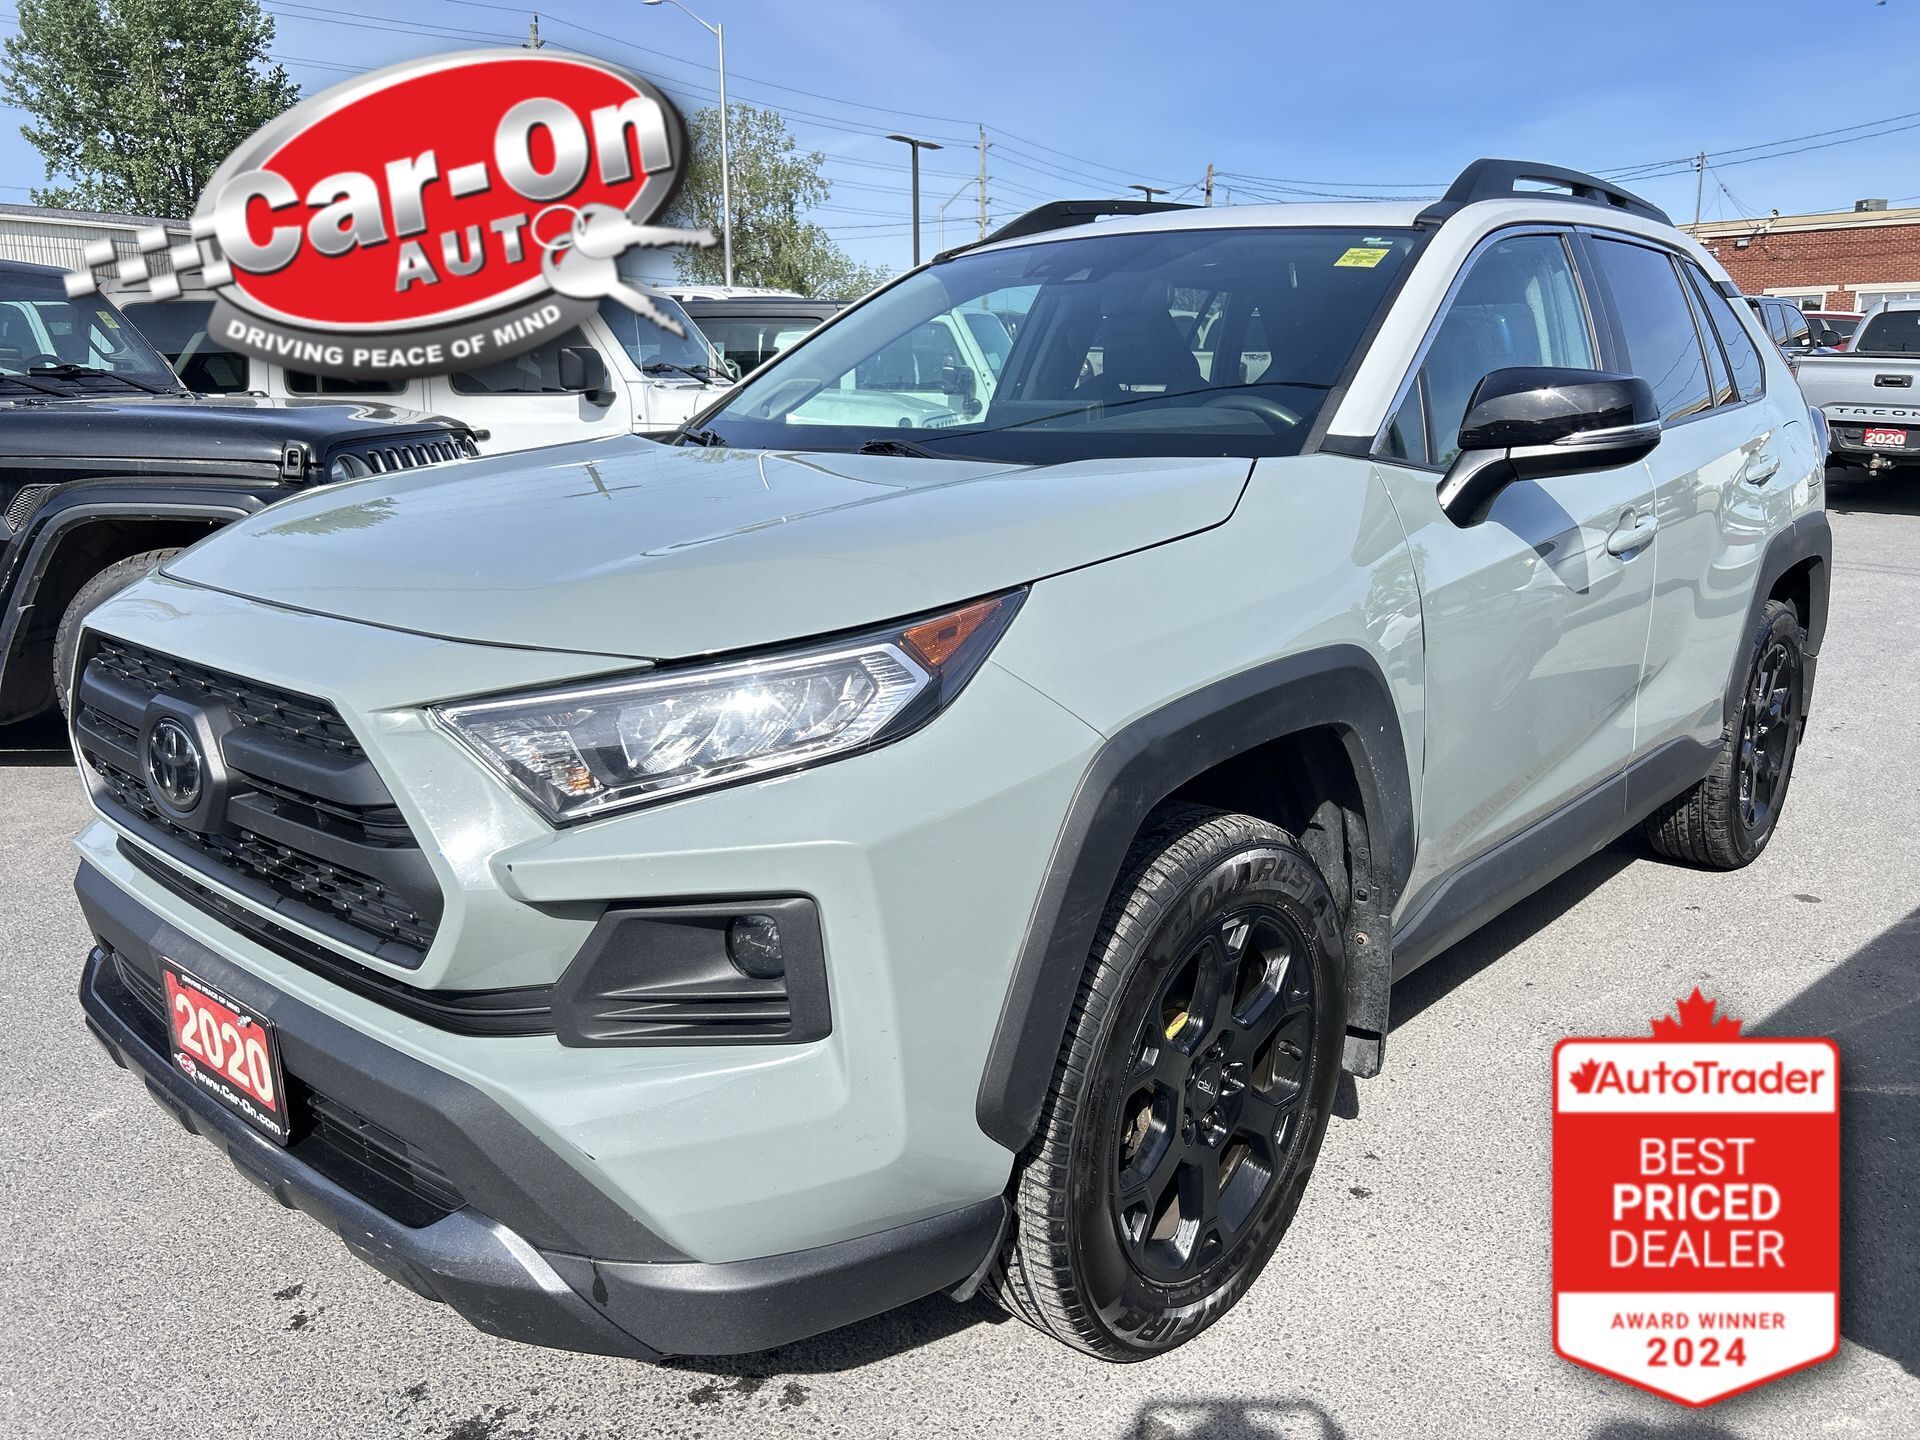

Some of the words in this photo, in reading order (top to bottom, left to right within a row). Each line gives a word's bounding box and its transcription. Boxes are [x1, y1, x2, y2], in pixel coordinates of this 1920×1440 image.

[1866, 432, 1905, 444] 2020
[175, 993, 274, 1103] 2020
[196, 1070, 281, 1136] www.Car-On.com
